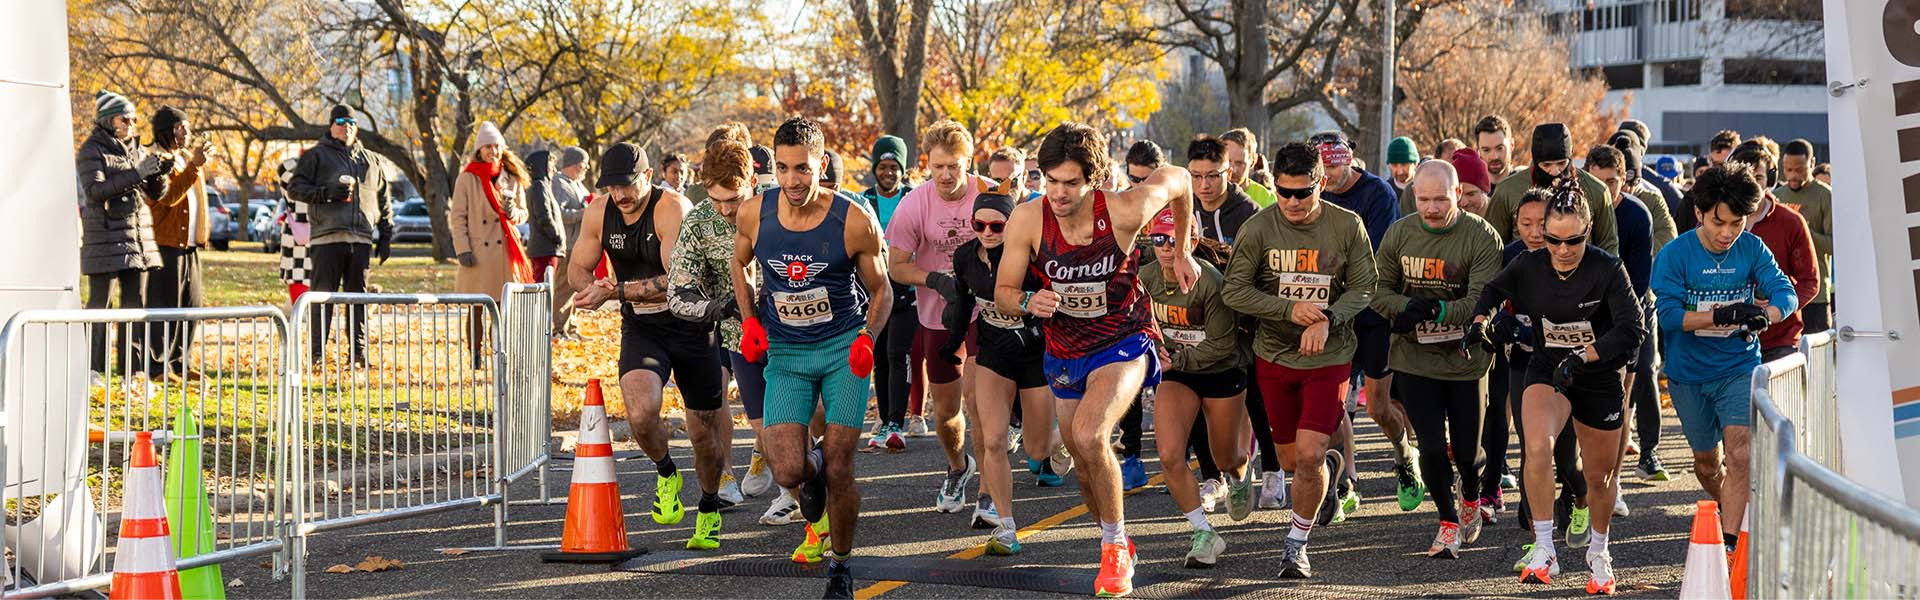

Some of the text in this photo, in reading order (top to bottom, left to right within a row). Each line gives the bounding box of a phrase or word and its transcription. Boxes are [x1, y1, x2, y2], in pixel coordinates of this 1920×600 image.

[782, 253, 814, 262] TRACK
[1268, 248, 1319, 273] GW5K
[791, 265, 803, 277] P
[1044, 253, 1117, 280] Cornell
[1400, 255, 1446, 281] GW5K
[1280, 286, 1328, 300] 4470
[778, 301, 829, 317] 4460
[1154, 302, 1191, 327] W5K
[1545, 331, 1593, 343] 4455
